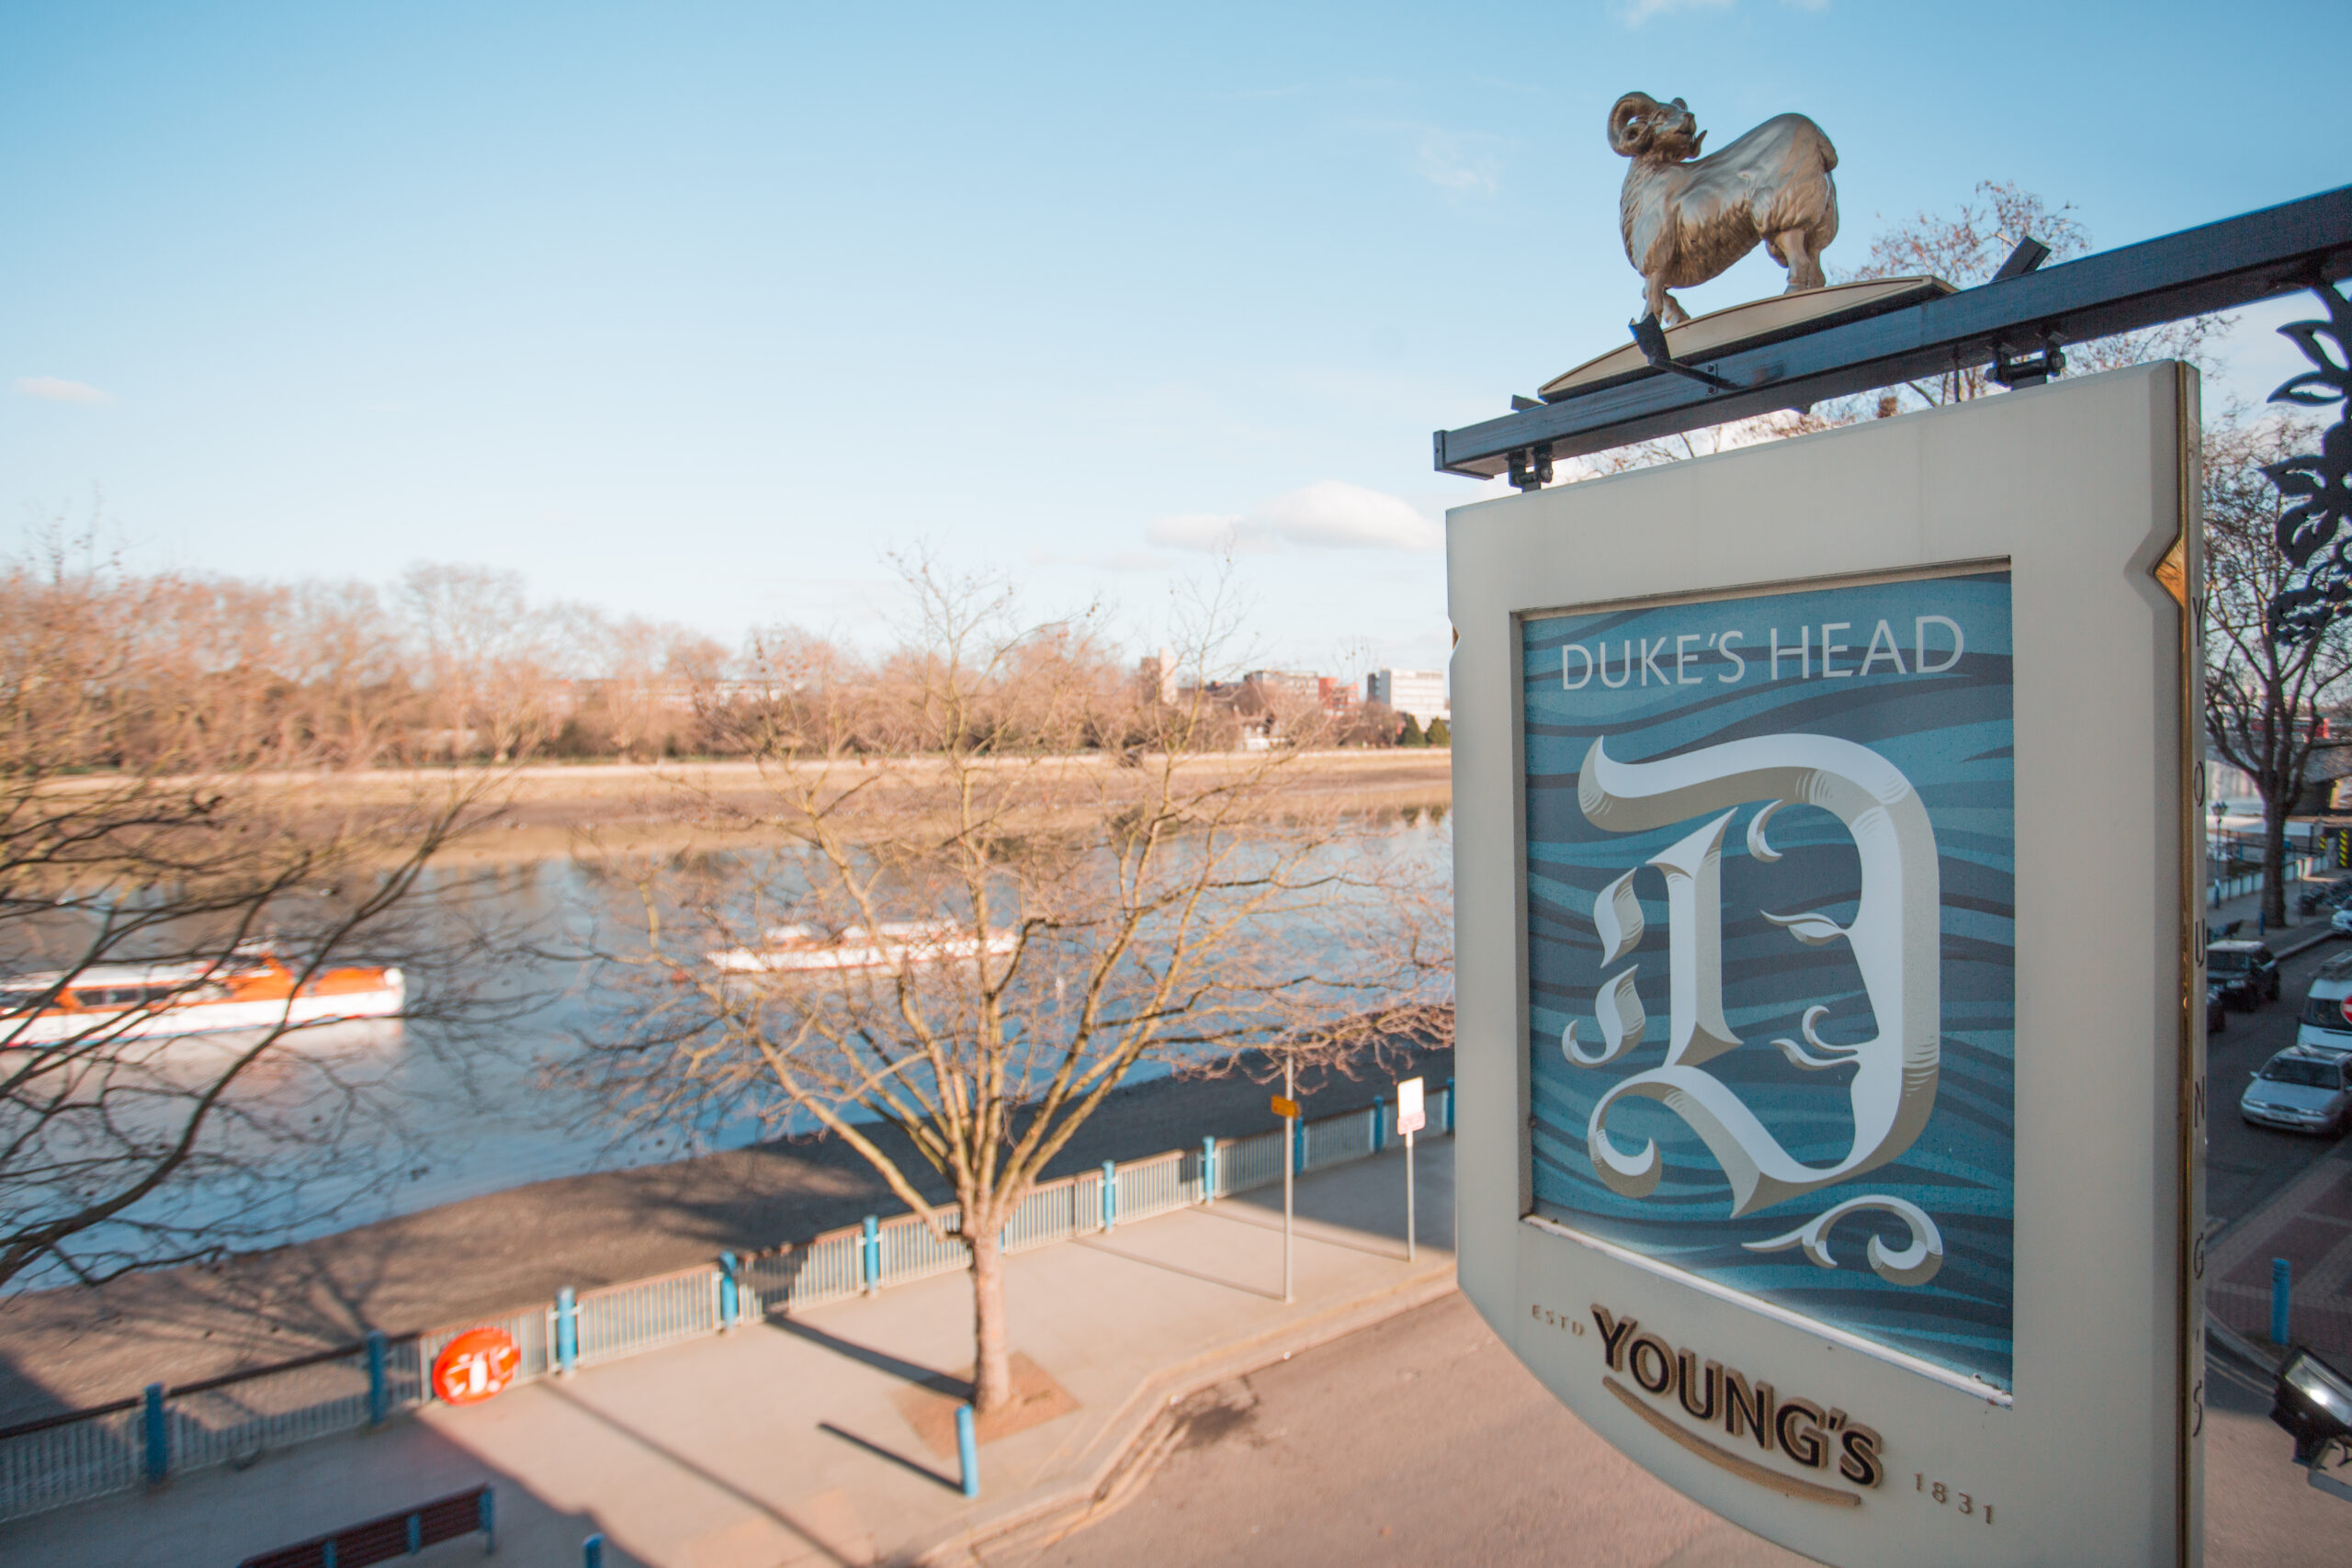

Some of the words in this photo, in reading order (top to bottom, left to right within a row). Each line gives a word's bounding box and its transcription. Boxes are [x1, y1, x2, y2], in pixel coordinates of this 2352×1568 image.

[1562, 630, 1746, 690] DUKE'S
[1770, 615, 1964, 681] HEAD
[1562, 733, 1941, 1219] D
[1532, 1303, 1586, 1337] ESTD
[1590, 1303, 1883, 1489] YOUNG'S
[1914, 1472, 1994, 1525] 1831
